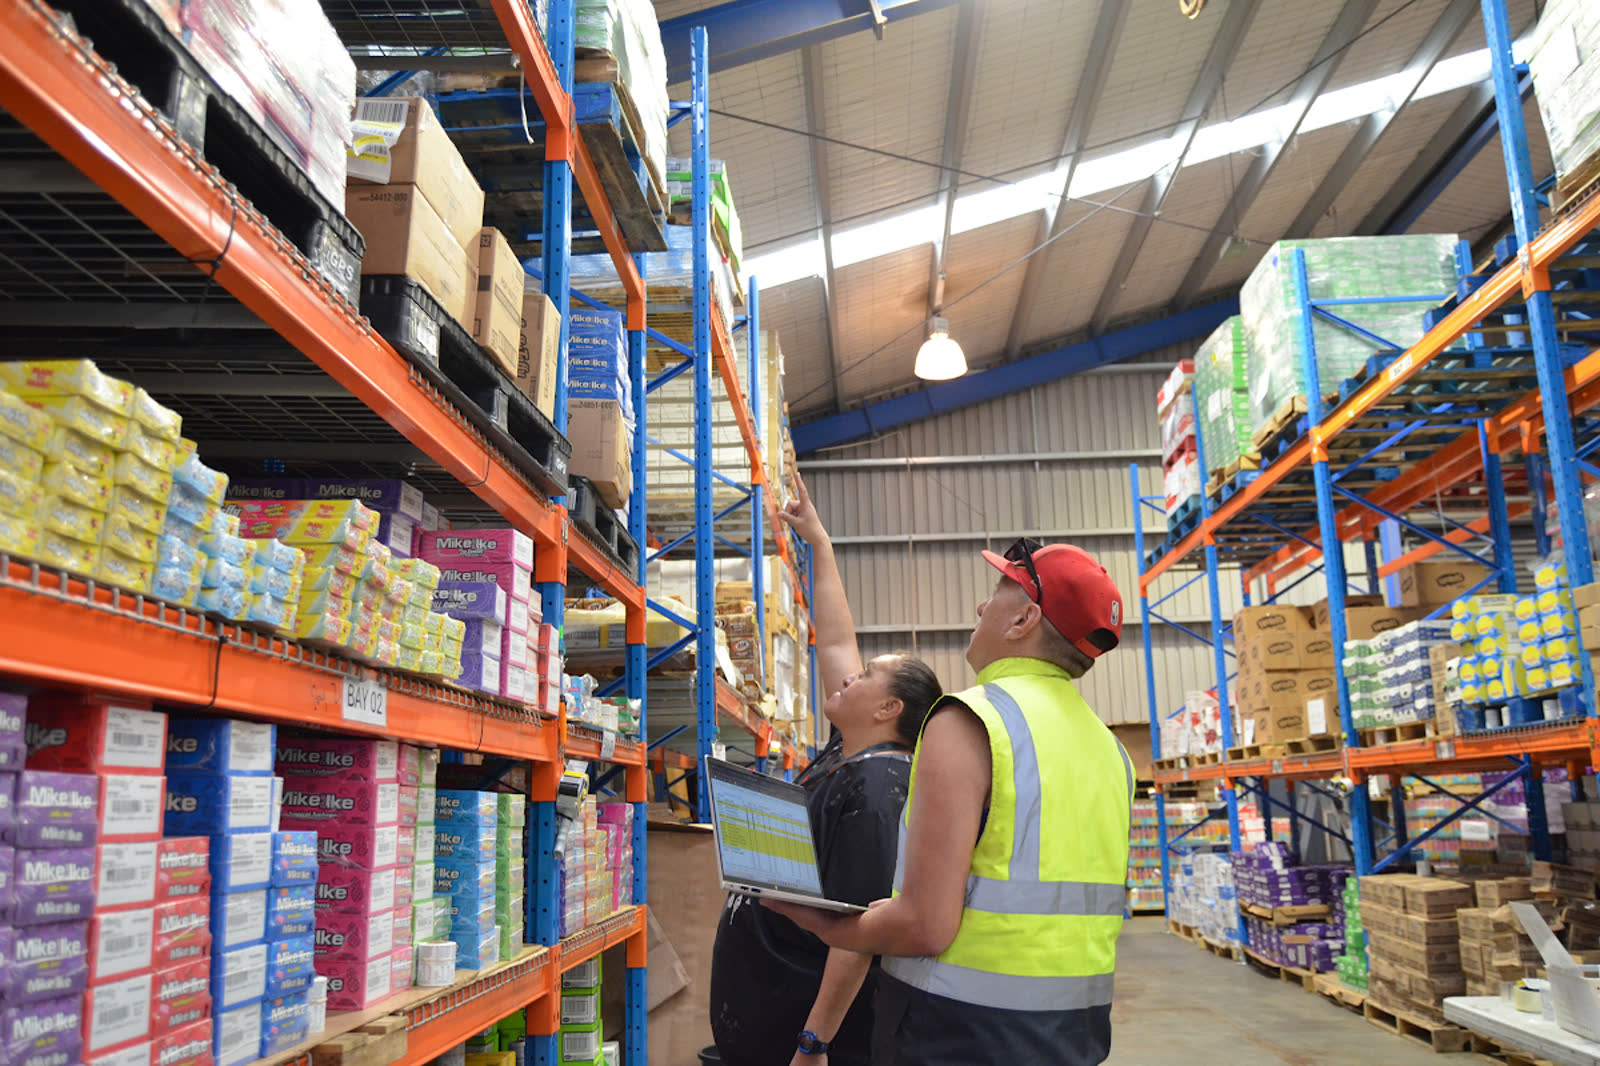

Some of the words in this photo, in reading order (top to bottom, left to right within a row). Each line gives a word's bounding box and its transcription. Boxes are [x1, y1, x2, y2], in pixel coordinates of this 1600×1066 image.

[319, 485, 357, 497] Mike
[360, 487, 383, 500] Ike
[436, 537, 472, 549] Mike
[475, 538, 497, 550] Ike
[475, 571, 497, 582] Ike
[453, 589, 478, 602] Ike
[347, 683, 369, 711] BAY
[371, 691, 383, 715] 02
[168, 734, 198, 752] ke
[277, 748, 320, 763] Mike
[326, 751, 354, 767] Ike
[30, 786, 70, 807] Mike
[71, 791, 92, 809] Ike
[281, 791, 321, 806] Mike
[326, 794, 354, 810] Ike
[440, 797, 461, 808] Ike
[440, 833, 461, 844] Ike
[324, 839, 352, 855] Ike
[25, 862, 65, 882] Mike
[66, 863, 90, 881] Ike
[439, 868, 460, 879] Ike
[319, 884, 347, 900] Ike
[315, 930, 345, 946] Ike
[17, 938, 56, 960] Mike
[59, 937, 80, 958] Ike
[13, 1015, 54, 1040] Mike
[55, 1012, 77, 1030] Ike
